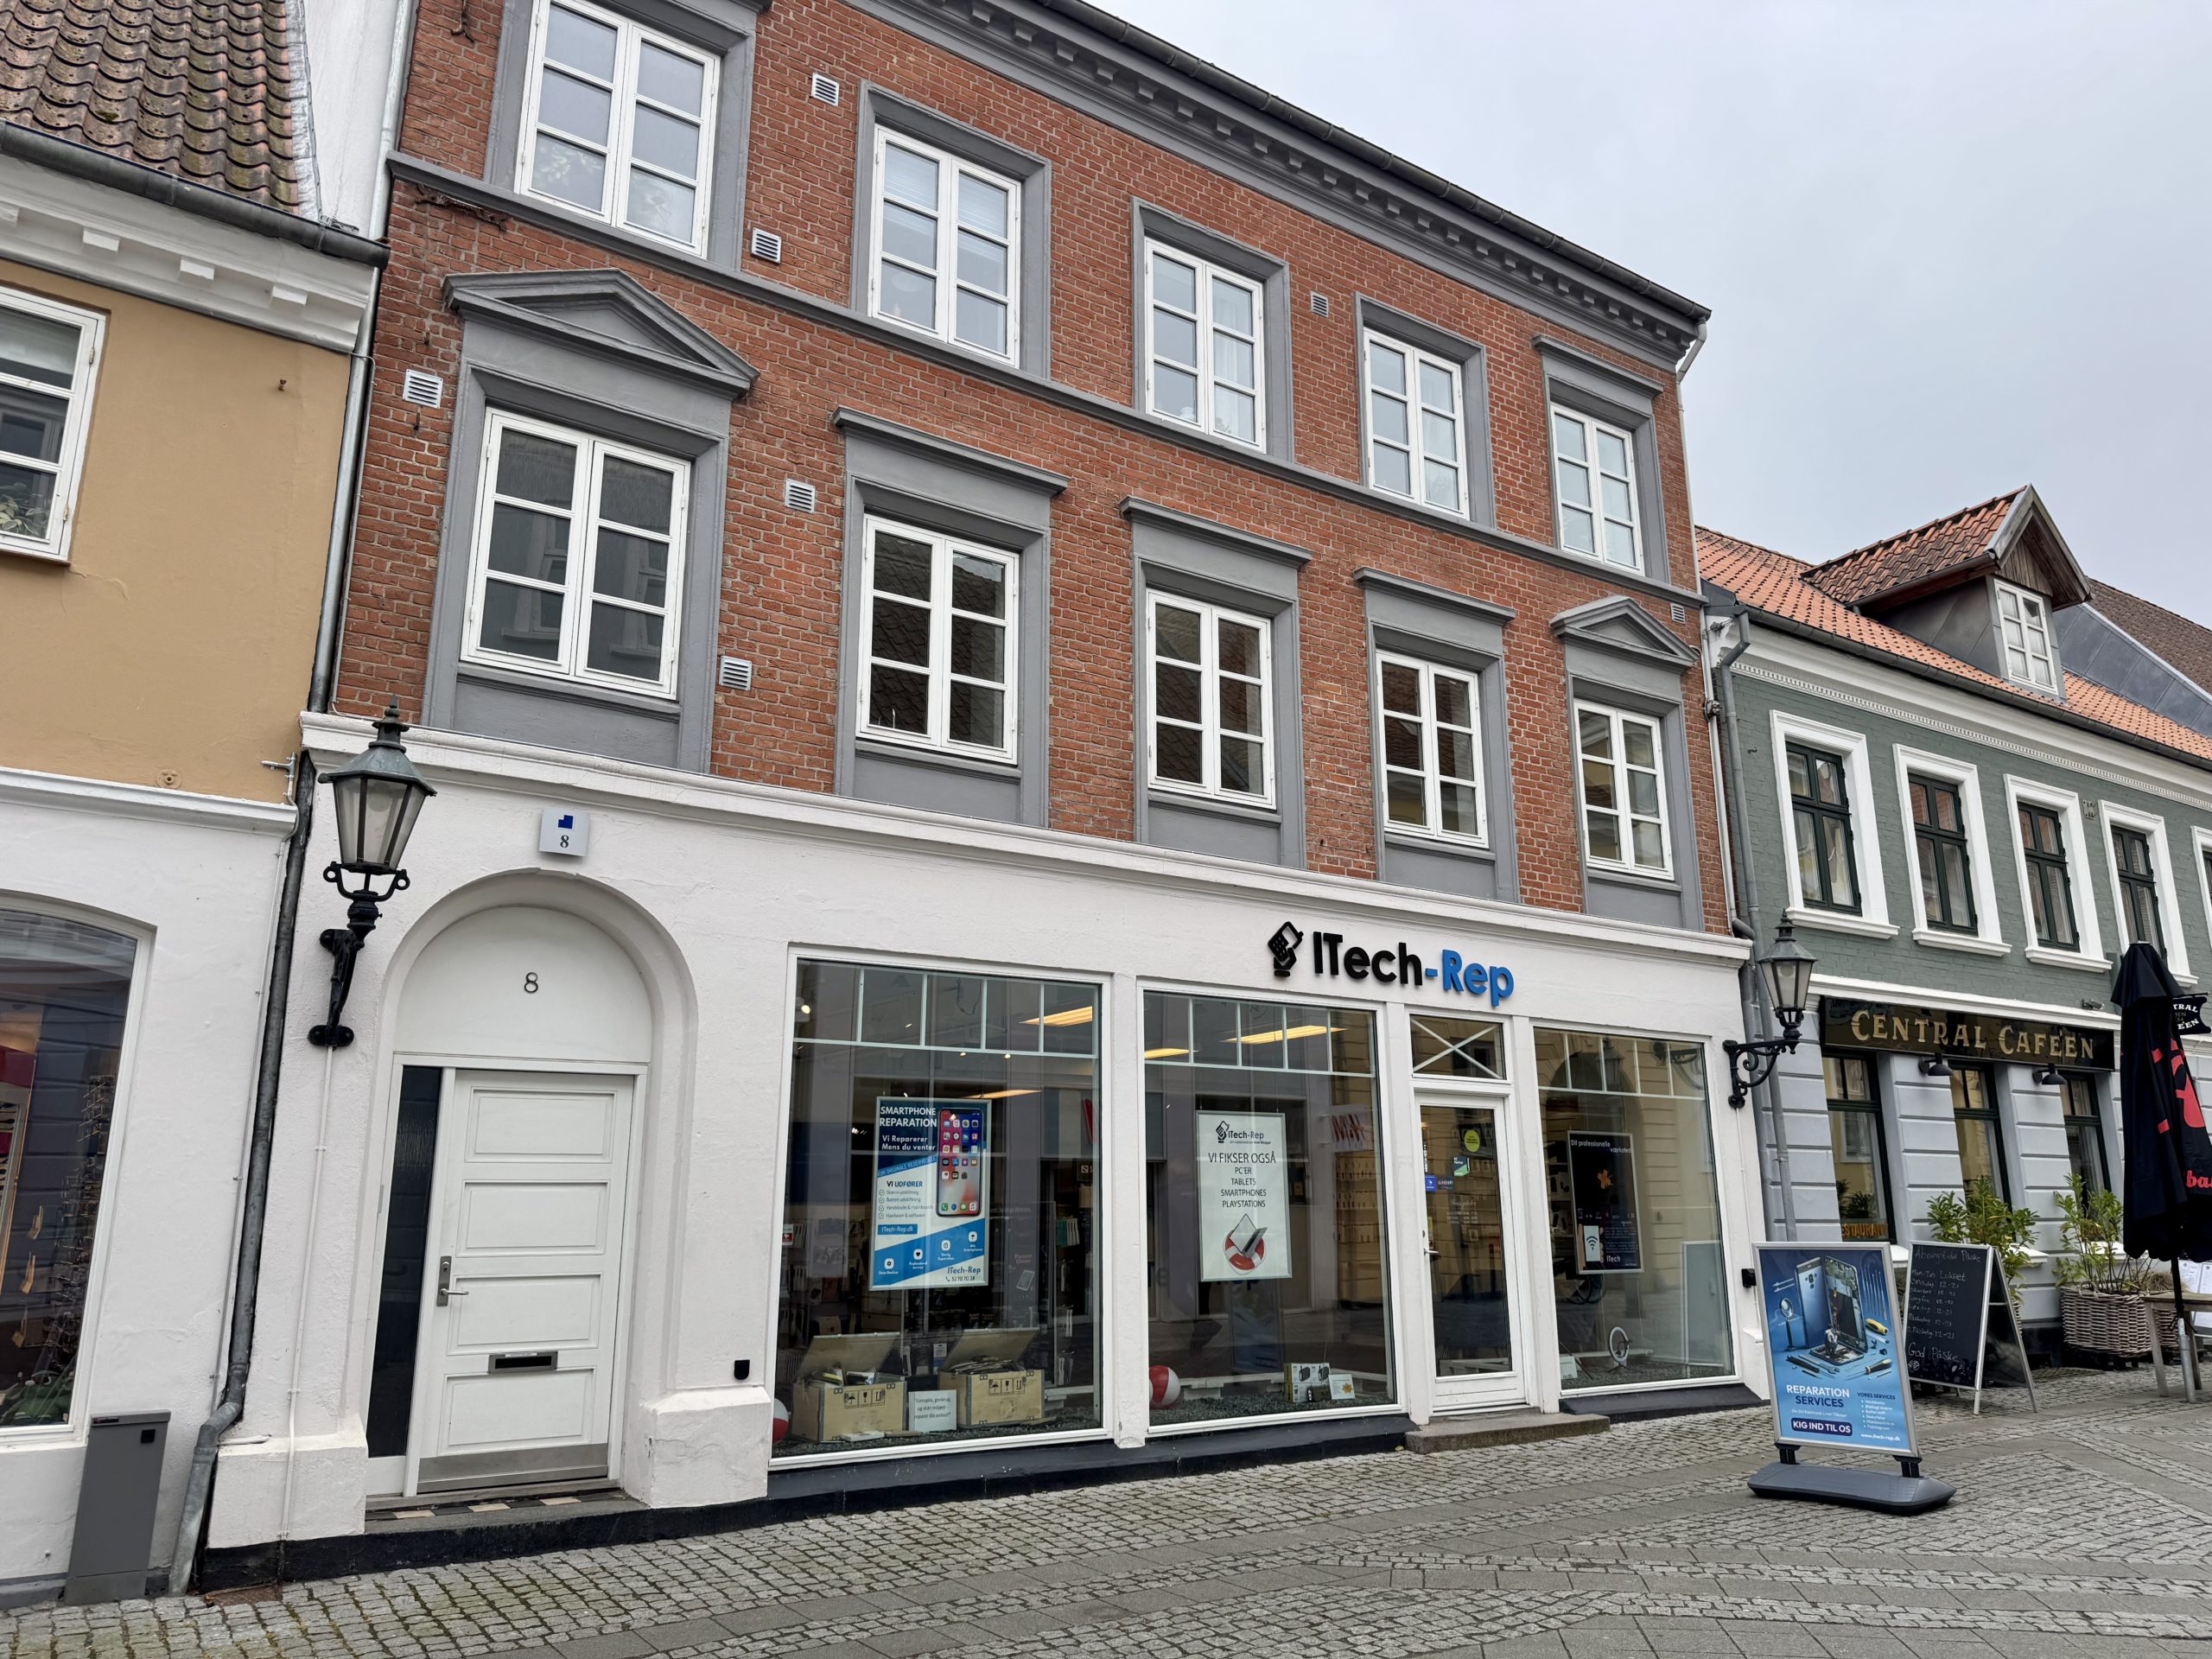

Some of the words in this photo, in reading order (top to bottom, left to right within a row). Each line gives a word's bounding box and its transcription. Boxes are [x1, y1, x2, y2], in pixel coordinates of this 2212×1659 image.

[560, 835, 569, 849] 8
[1313, 931, 1514, 1007] ITech-Rep
[524, 972, 539, 994] 8
[2172, 1003, 2199, 1014] TRAL
[1851, 1009, 1986, 1049] CENTRAL
[880, 1106, 937, 1116] SMARTPHONE
[880, 1117, 938, 1128] REPARATION
[892, 1135, 928, 1143] Reparerer
[1228, 1130, 1264, 1141] ITech-Rep
[1208, 1153, 1217, 1163] VI
[1219, 1153, 1249, 1164] FIKSER
[1251, 1151, 1276, 1164] OGSÅ
[947, 1266, 982, 1275] ITech-Rep
[1908, 1342, 1926, 1358] God
[1932, 1347, 1960, 1363] Påske
[1786, 1384, 1850, 1397] REPARATION
[1796, 1395, 1844, 1408] SERVICES
[1793, 1421, 1808, 1429] KIG
